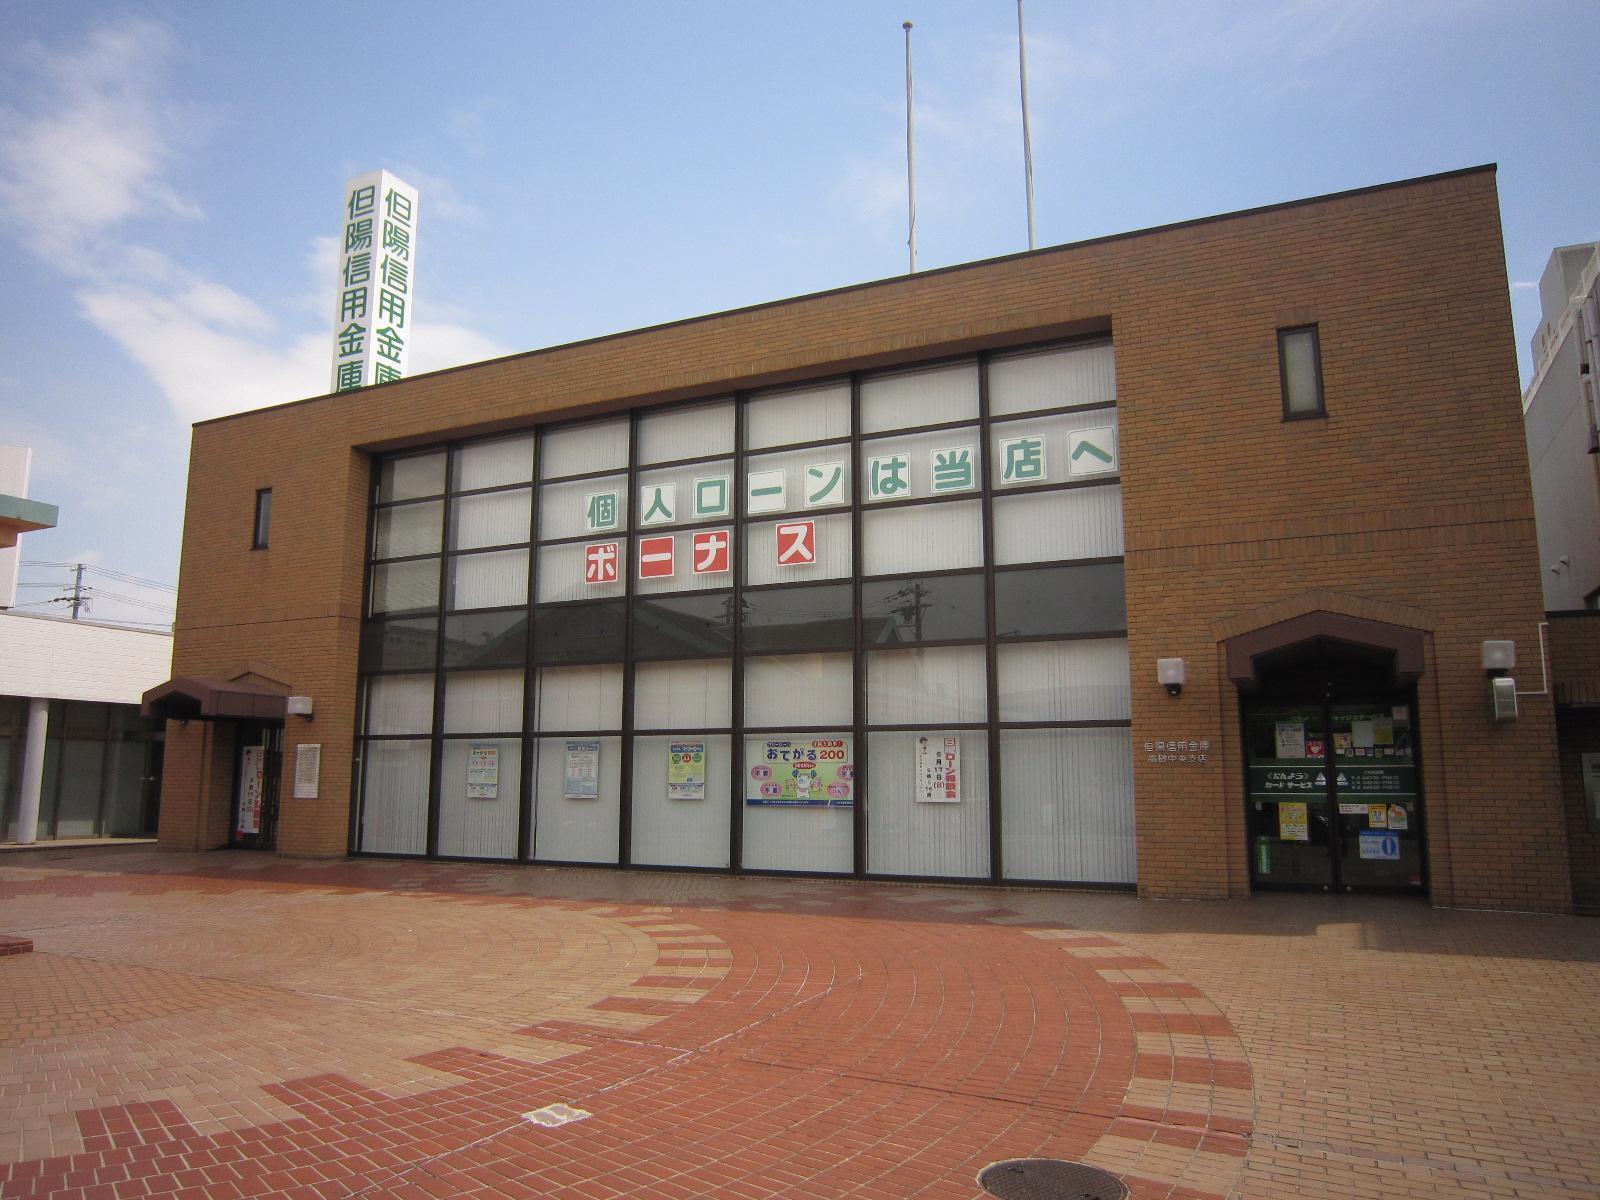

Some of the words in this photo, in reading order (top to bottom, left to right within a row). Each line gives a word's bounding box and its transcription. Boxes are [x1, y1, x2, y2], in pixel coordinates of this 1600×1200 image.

[586, 524, 813, 580] ボーナス
[766, 748, 817, 761] おてがる
[819, 750, 845, 760] 200
